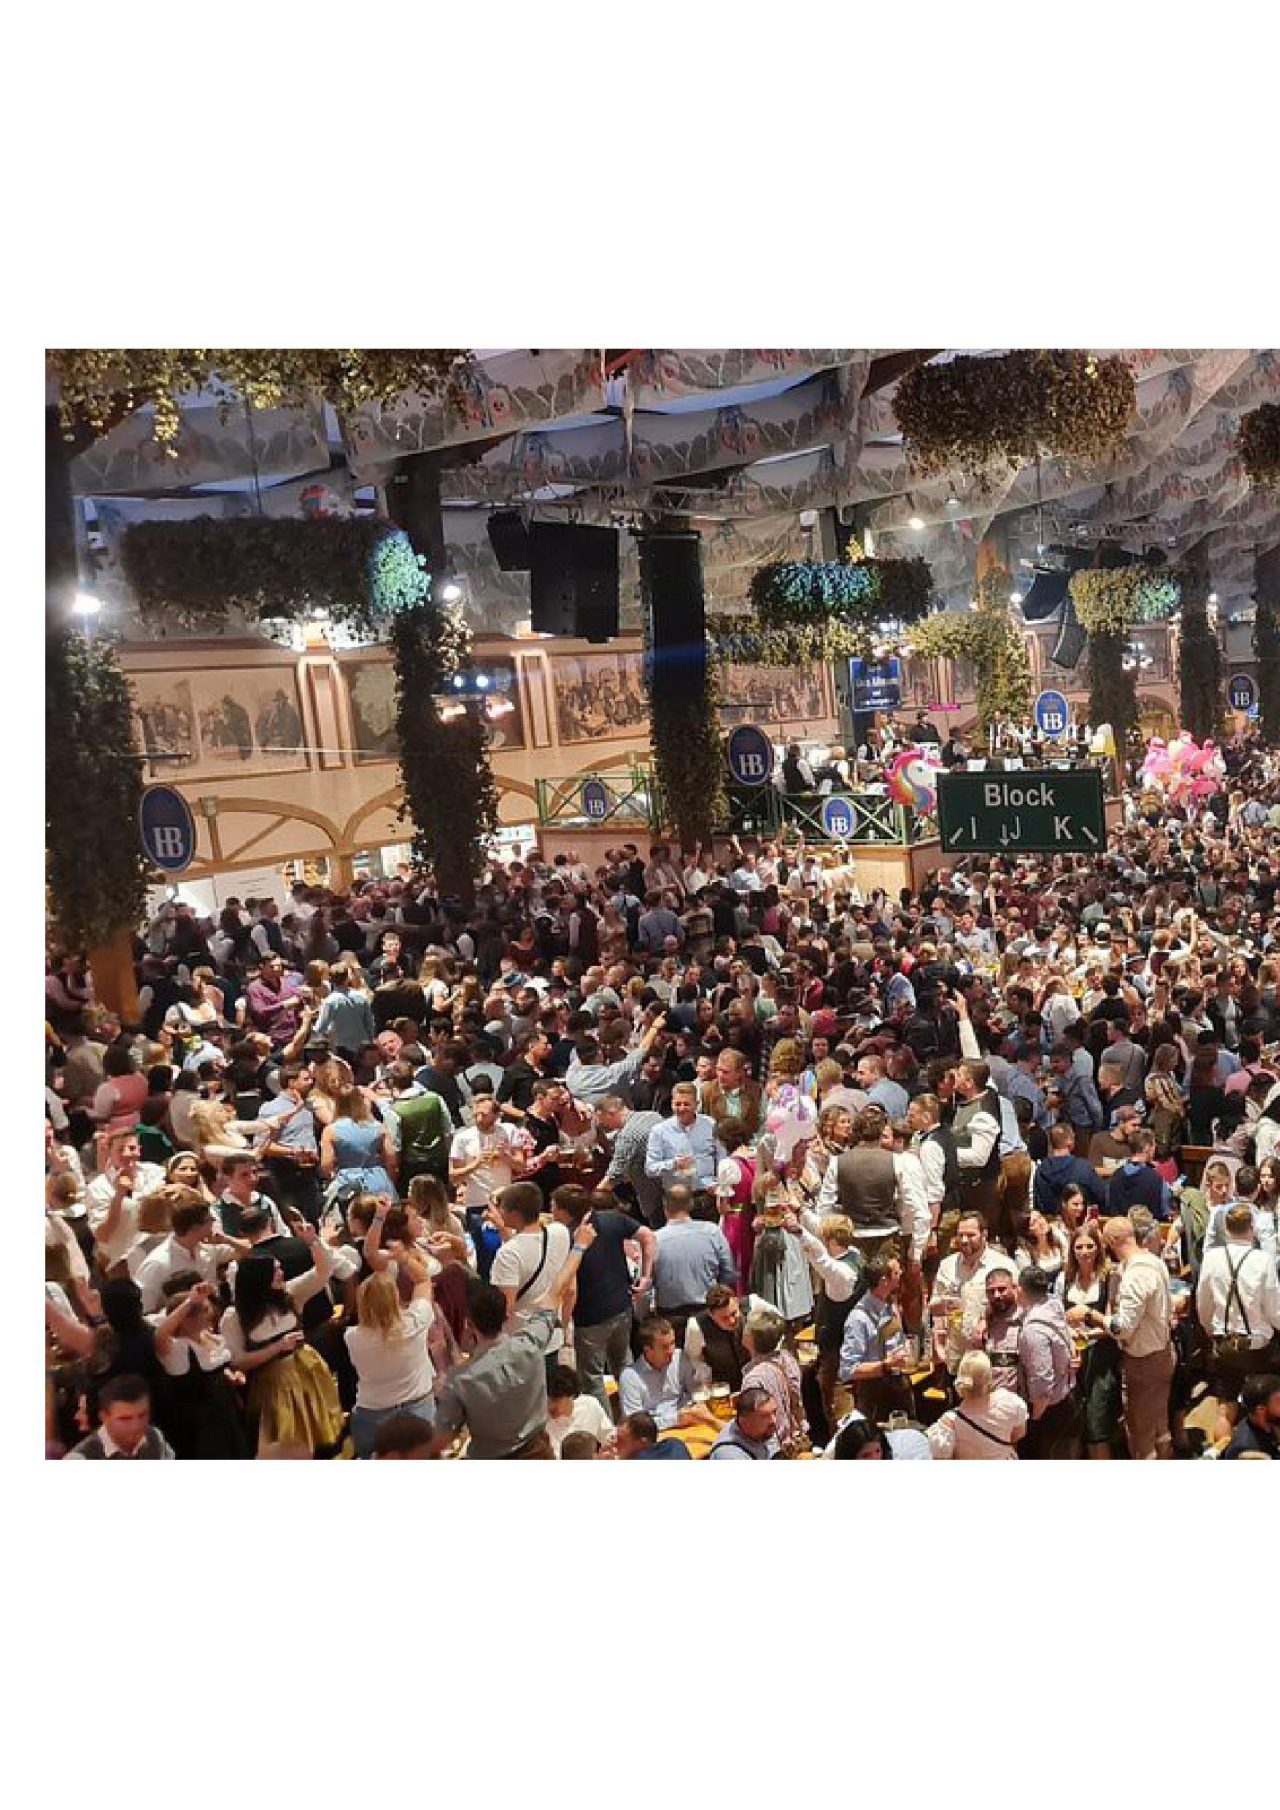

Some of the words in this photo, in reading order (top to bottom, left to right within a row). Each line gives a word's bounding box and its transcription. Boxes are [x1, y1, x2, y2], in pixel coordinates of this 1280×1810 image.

[1234, 692, 1250, 706] HB
[1042, 713, 1063, 730] HB
[738, 753, 765, 776] HB
[984, 782, 1056, 807] Block
[970, 816, 978, 840] I
[1010, 815, 1021, 840] J
[1053, 816, 1074, 840] K
[152, 827, 184, 858] HB
